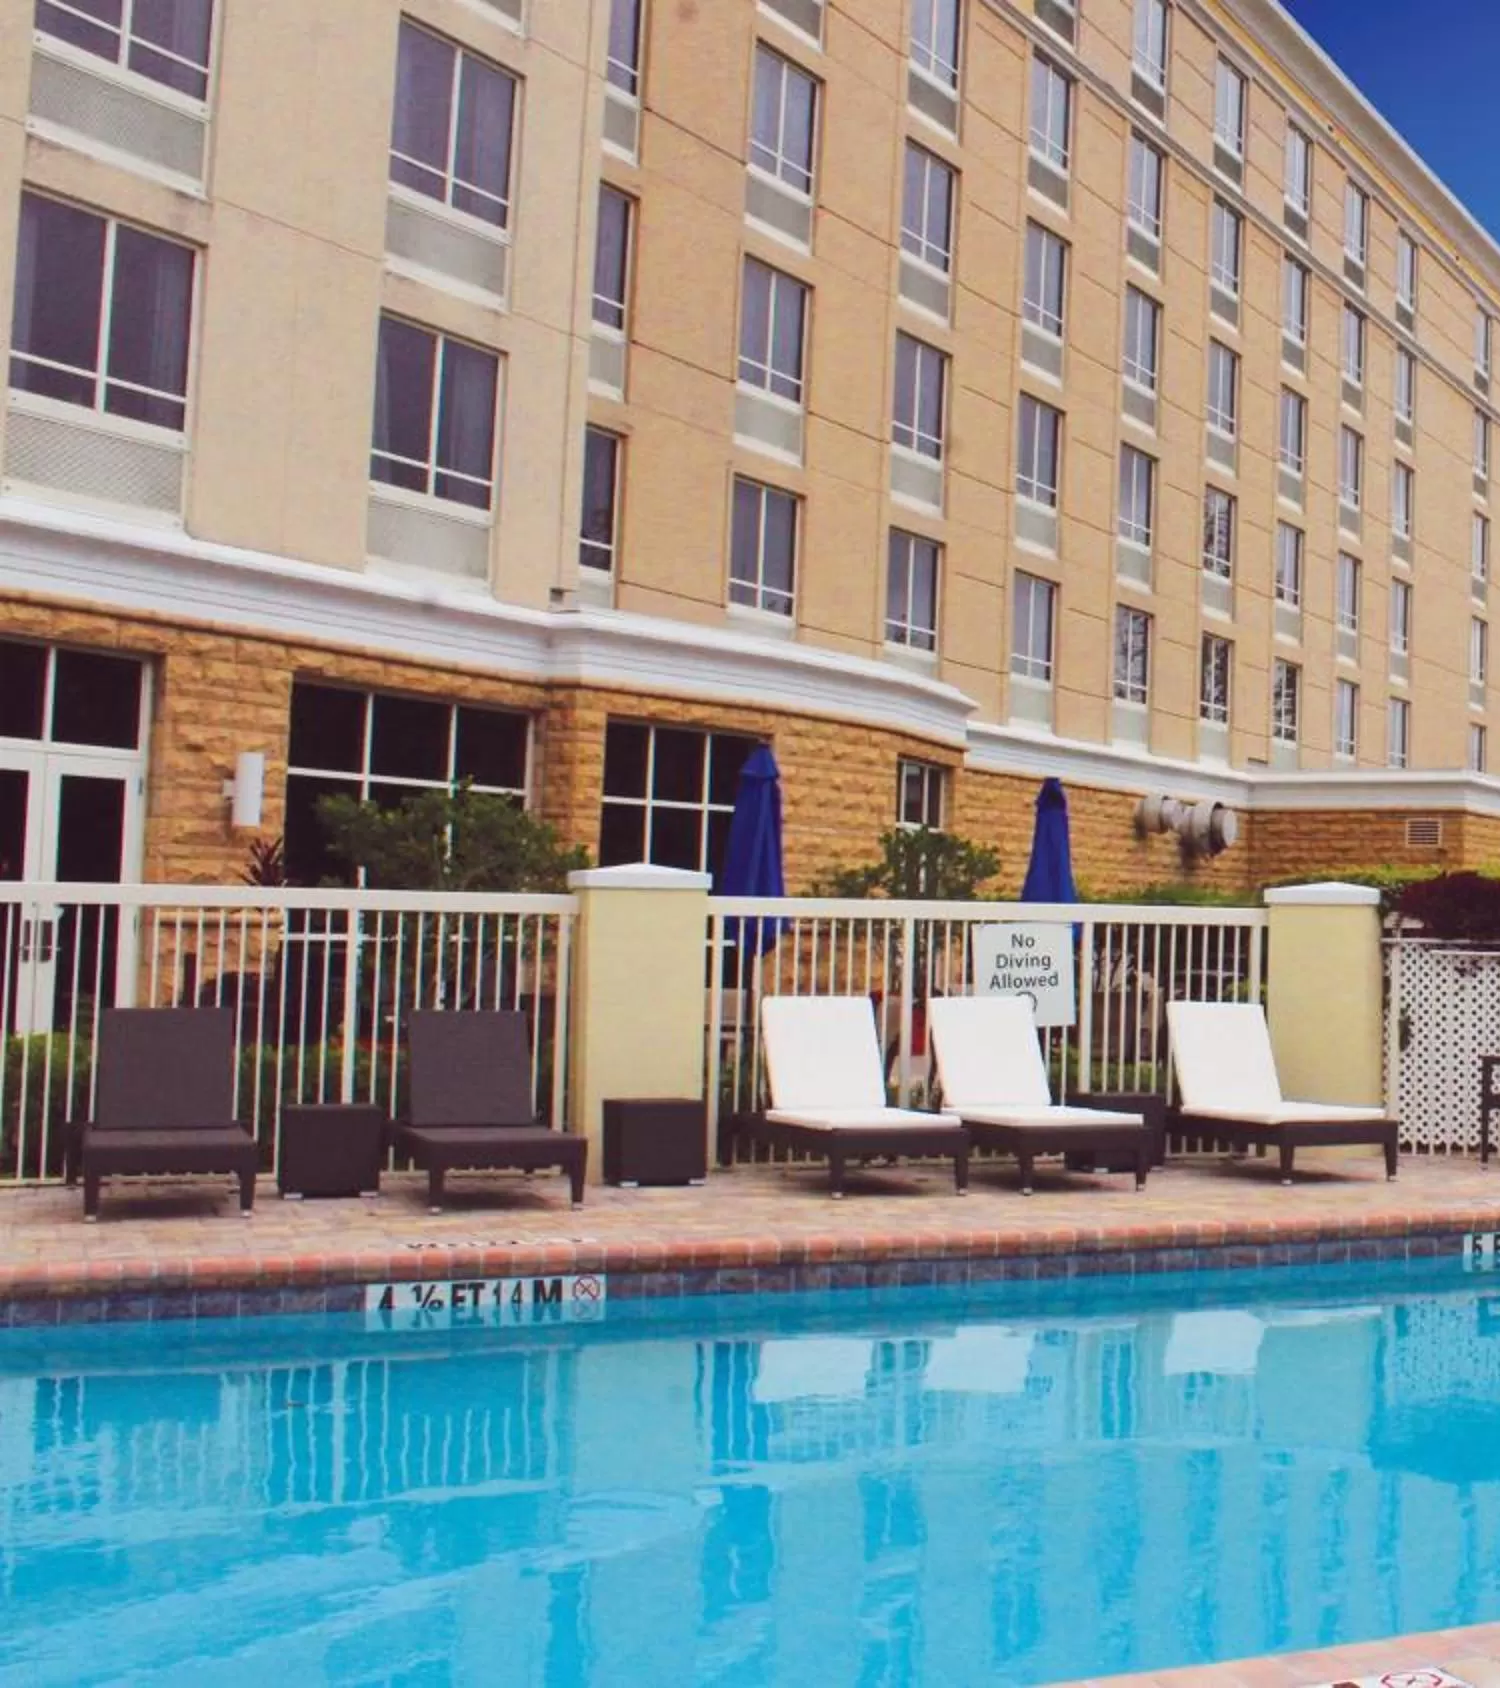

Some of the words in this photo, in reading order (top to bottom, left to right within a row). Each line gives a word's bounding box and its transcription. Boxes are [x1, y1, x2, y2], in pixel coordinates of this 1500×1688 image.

[1011, 933, 1036, 949] No
[995, 952, 1051, 970] Diving
[989, 972, 1059, 990] Allowed
